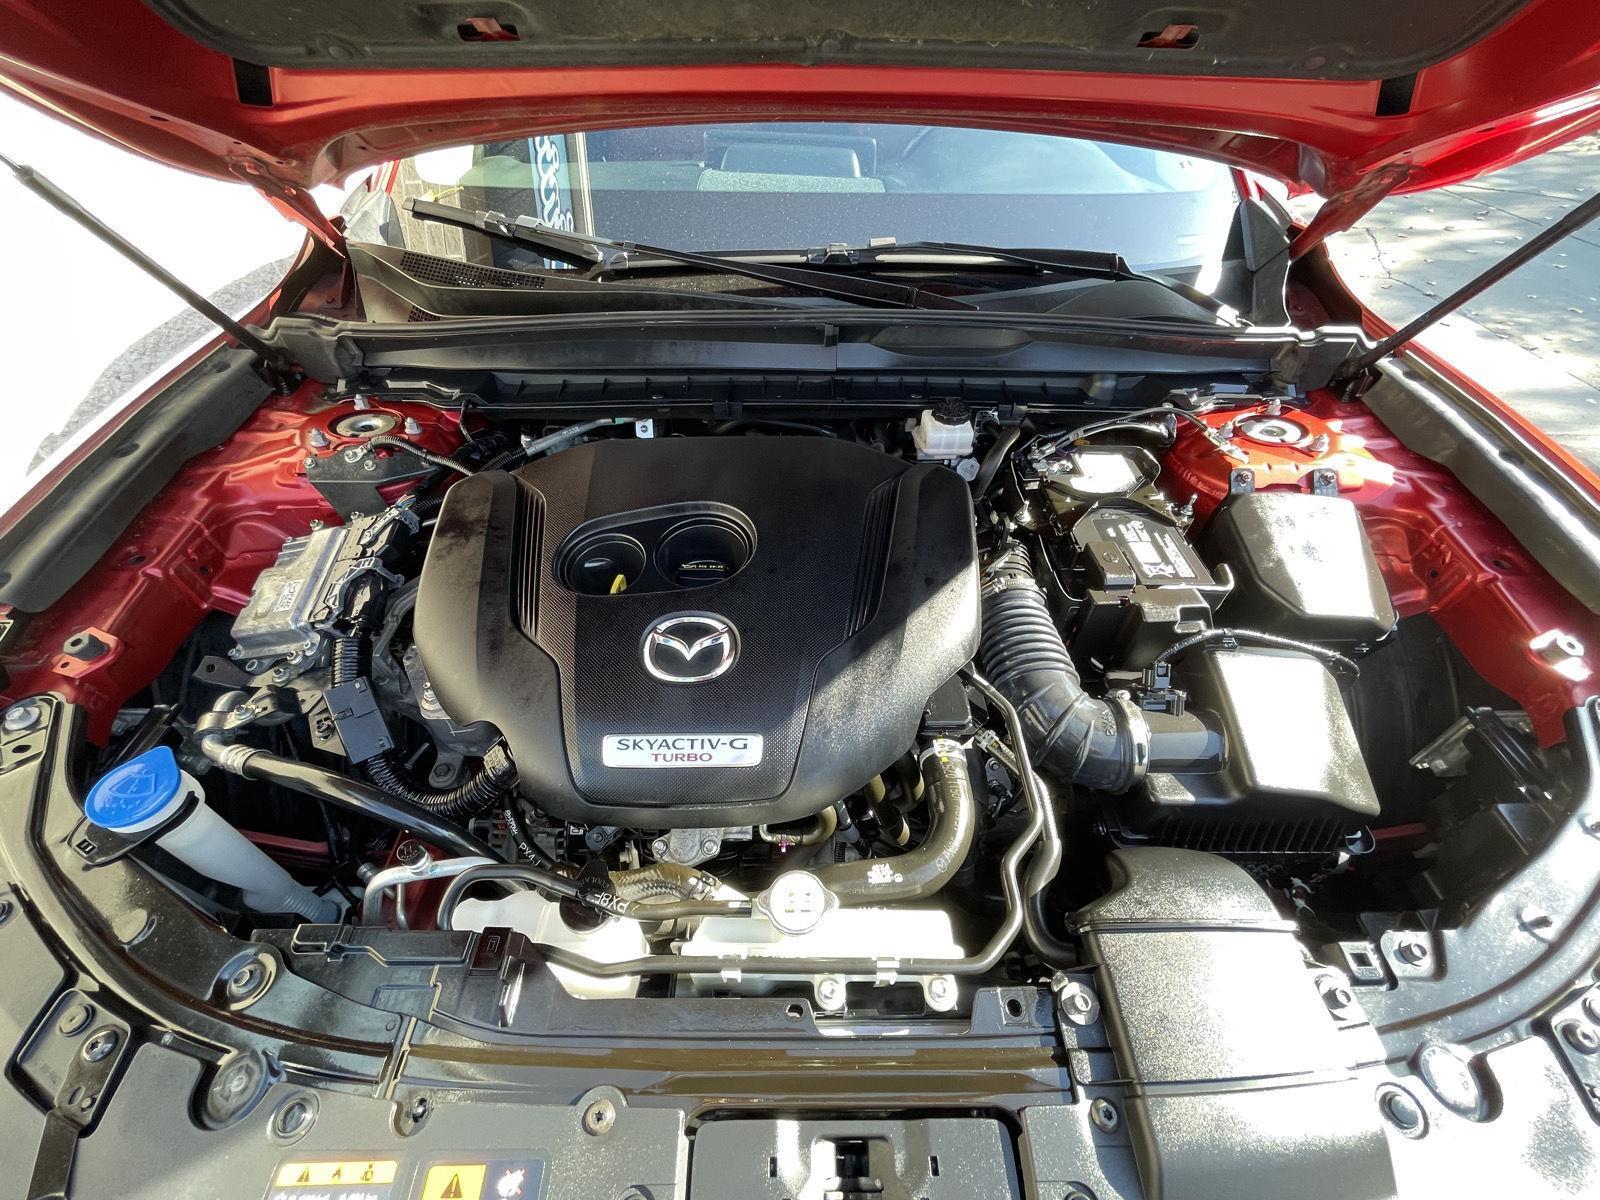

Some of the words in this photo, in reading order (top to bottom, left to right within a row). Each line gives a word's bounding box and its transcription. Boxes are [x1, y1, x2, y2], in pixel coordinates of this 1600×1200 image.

[616, 738, 748, 751] SKYACTIV-G
[651, 753, 713, 762] TURBO
[594, 891, 631, 914] PX8F
